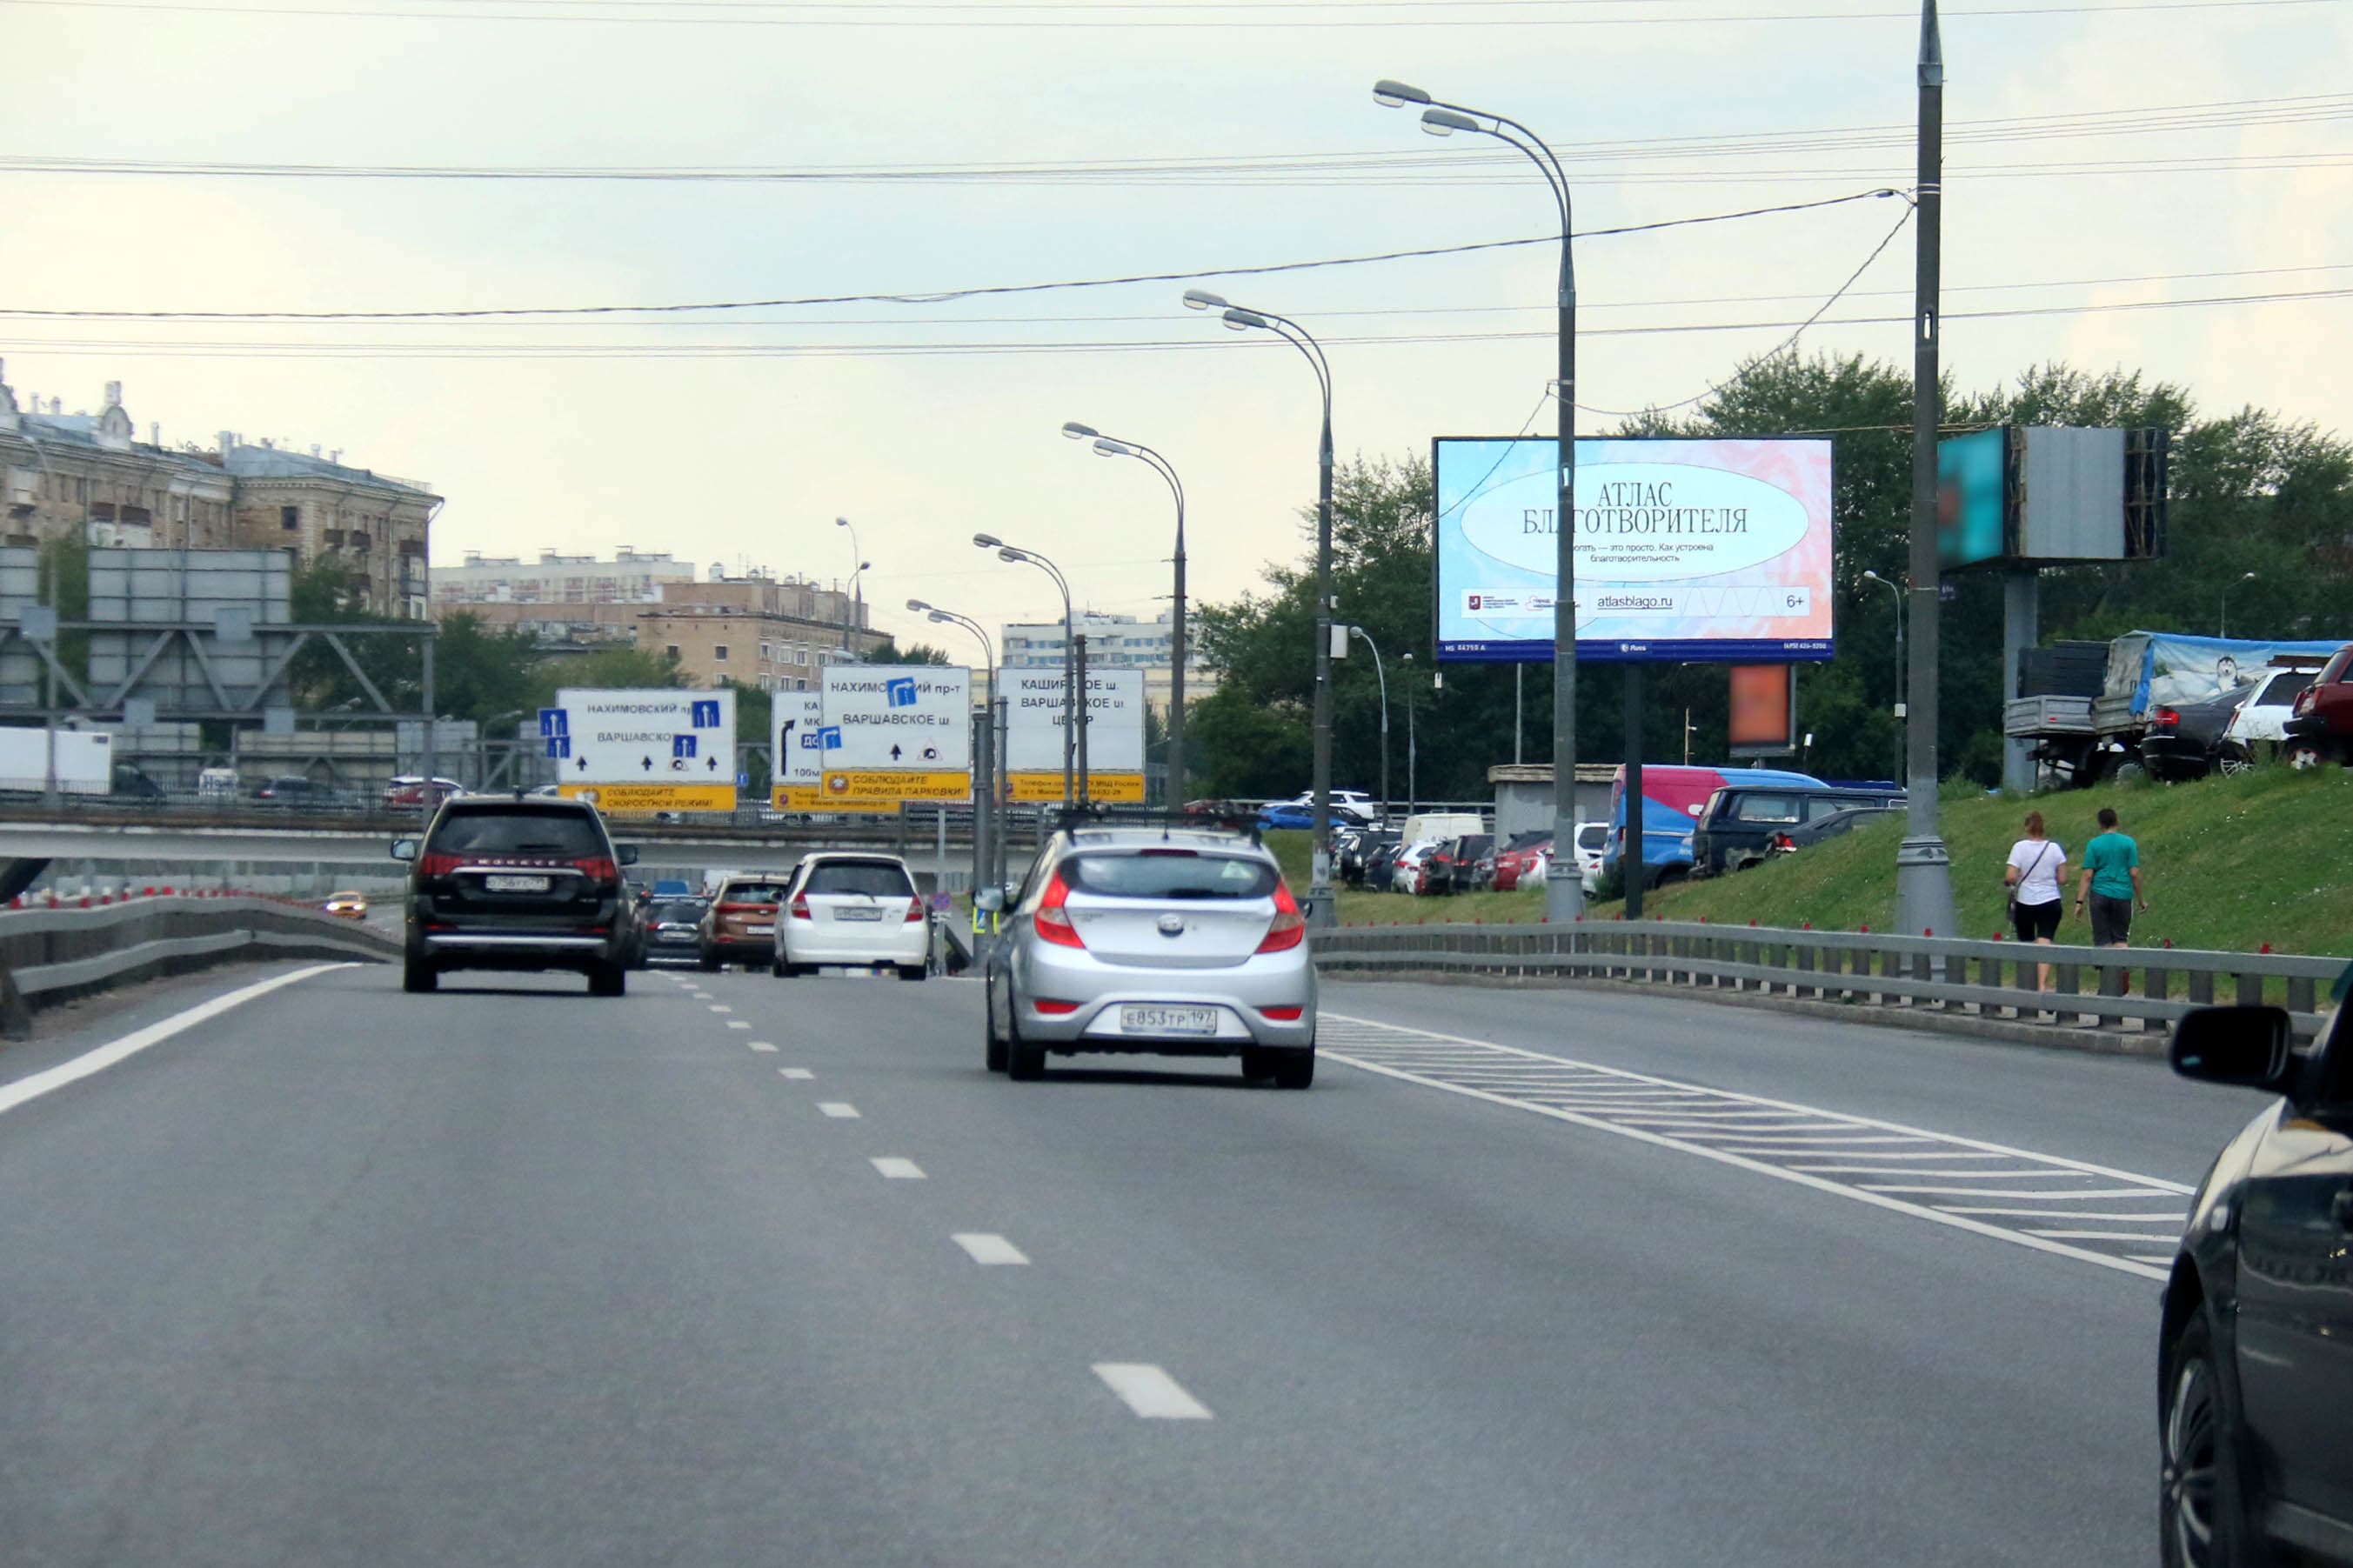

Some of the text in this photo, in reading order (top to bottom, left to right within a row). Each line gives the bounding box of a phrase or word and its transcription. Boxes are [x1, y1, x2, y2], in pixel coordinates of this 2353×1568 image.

[1597, 482, 1673, 507] АТЛАС
[1522, 509, 1748, 533] БЛГОТВОРИТЕЛЯ
[1626, 544, 1656, 554] просто.
[1659, 543, 1674, 552] Как
[1590, 554, 1681, 564] благотворительность
[1597, 596, 1673, 610] atlasblago.ru
[1787, 595, 1804, 608] 6+
[831, 682, 961, 696] НАХИМОИЙ пр-т
[1021, 679, 1102, 690] КАШИРОЕ
[1021, 697, 1110, 708] ВАРШАКОЕ
[587, 703, 677, 714] НАХИМОВСКИЙ
[843, 713, 950, 725] ВАРШАВСКОЕ ш
[1053, 715, 1093, 726] ЦЕНР
[598, 731, 674, 743] ВАРШАВСКО
[852, 775, 928, 785] СОБЛЮДАЙТЕ
[606, 787, 676, 797] СОБЛЮДАЙТЕ
[852, 786, 902, 796] ПРАВИЛА
[1126, 1010, 1212, 1026] Е853ТР 197
